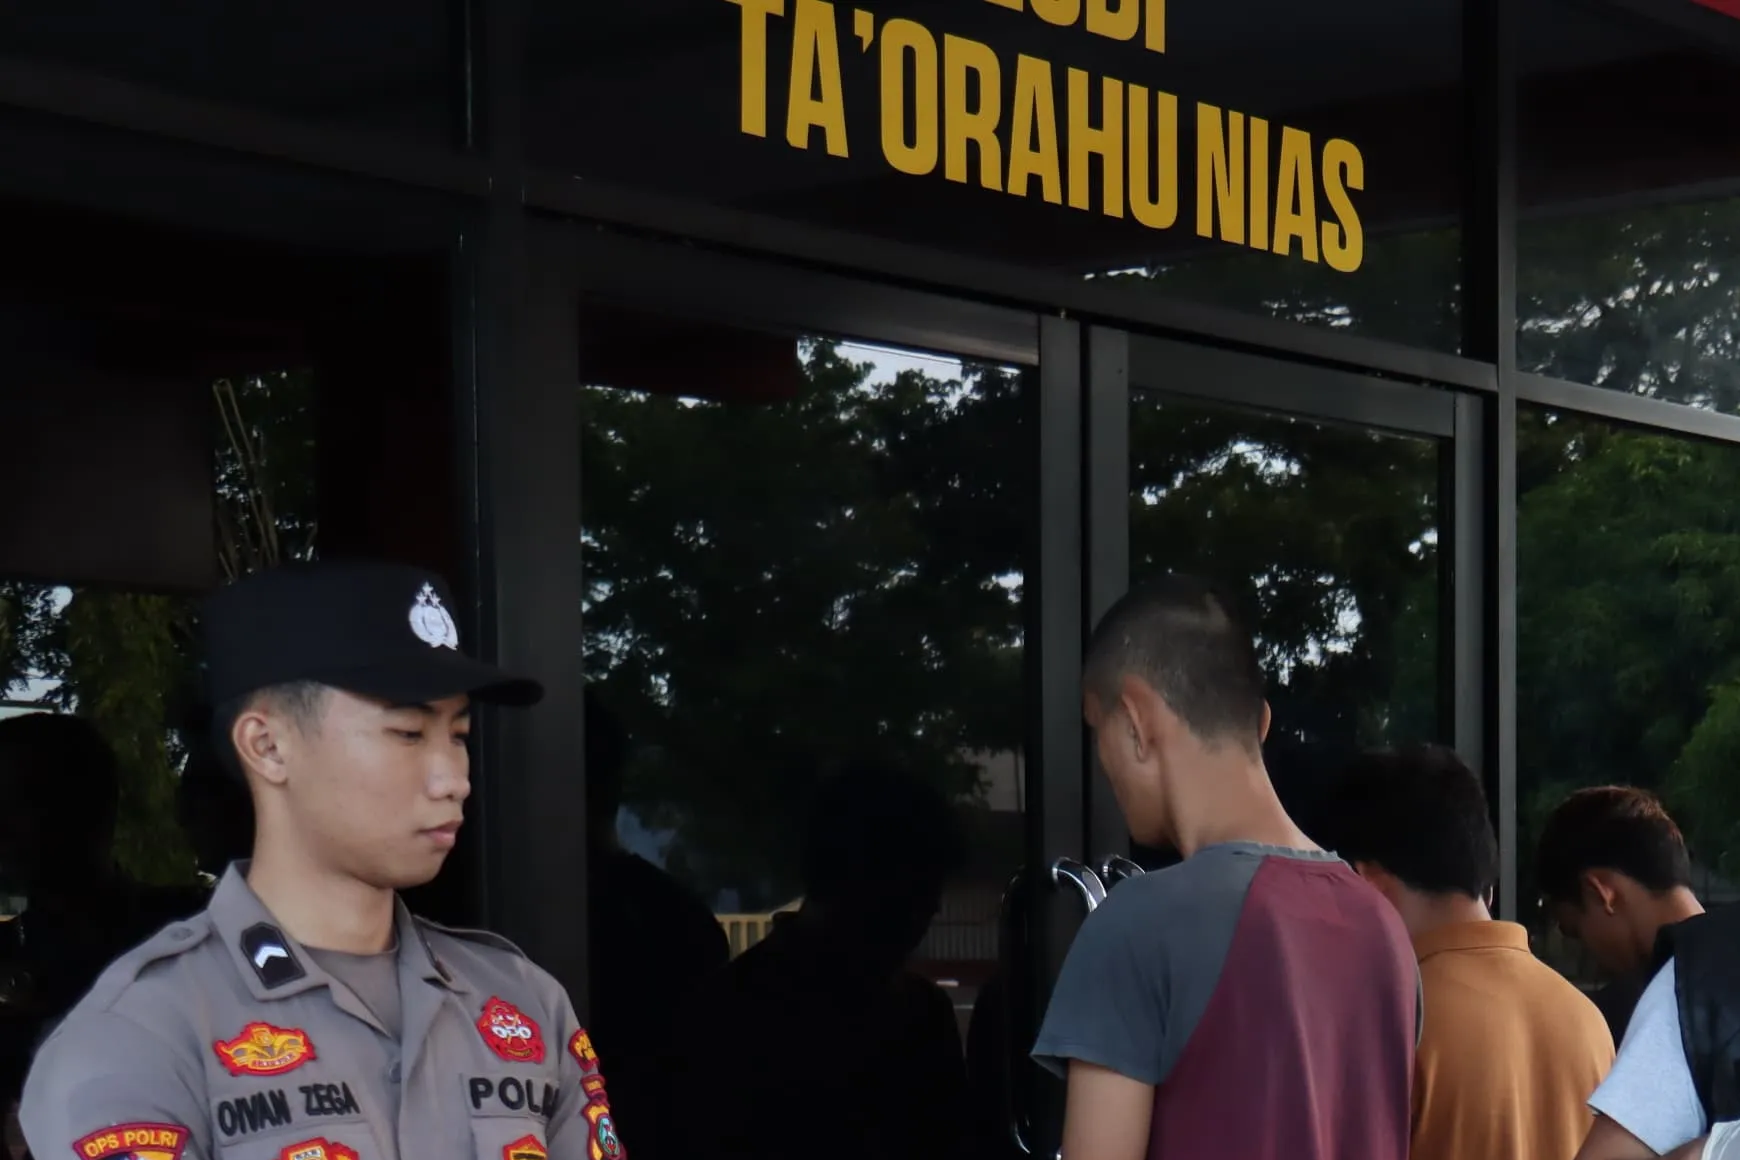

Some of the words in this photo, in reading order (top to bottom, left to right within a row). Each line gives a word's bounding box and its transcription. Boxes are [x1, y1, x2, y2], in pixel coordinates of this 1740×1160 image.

[1197, 102, 1364, 273] NIAS
[298, 1081, 361, 1116] ZEGA
[83, 1132, 119, 1157] OPS
[124, 1129, 179, 1149] POLRI
